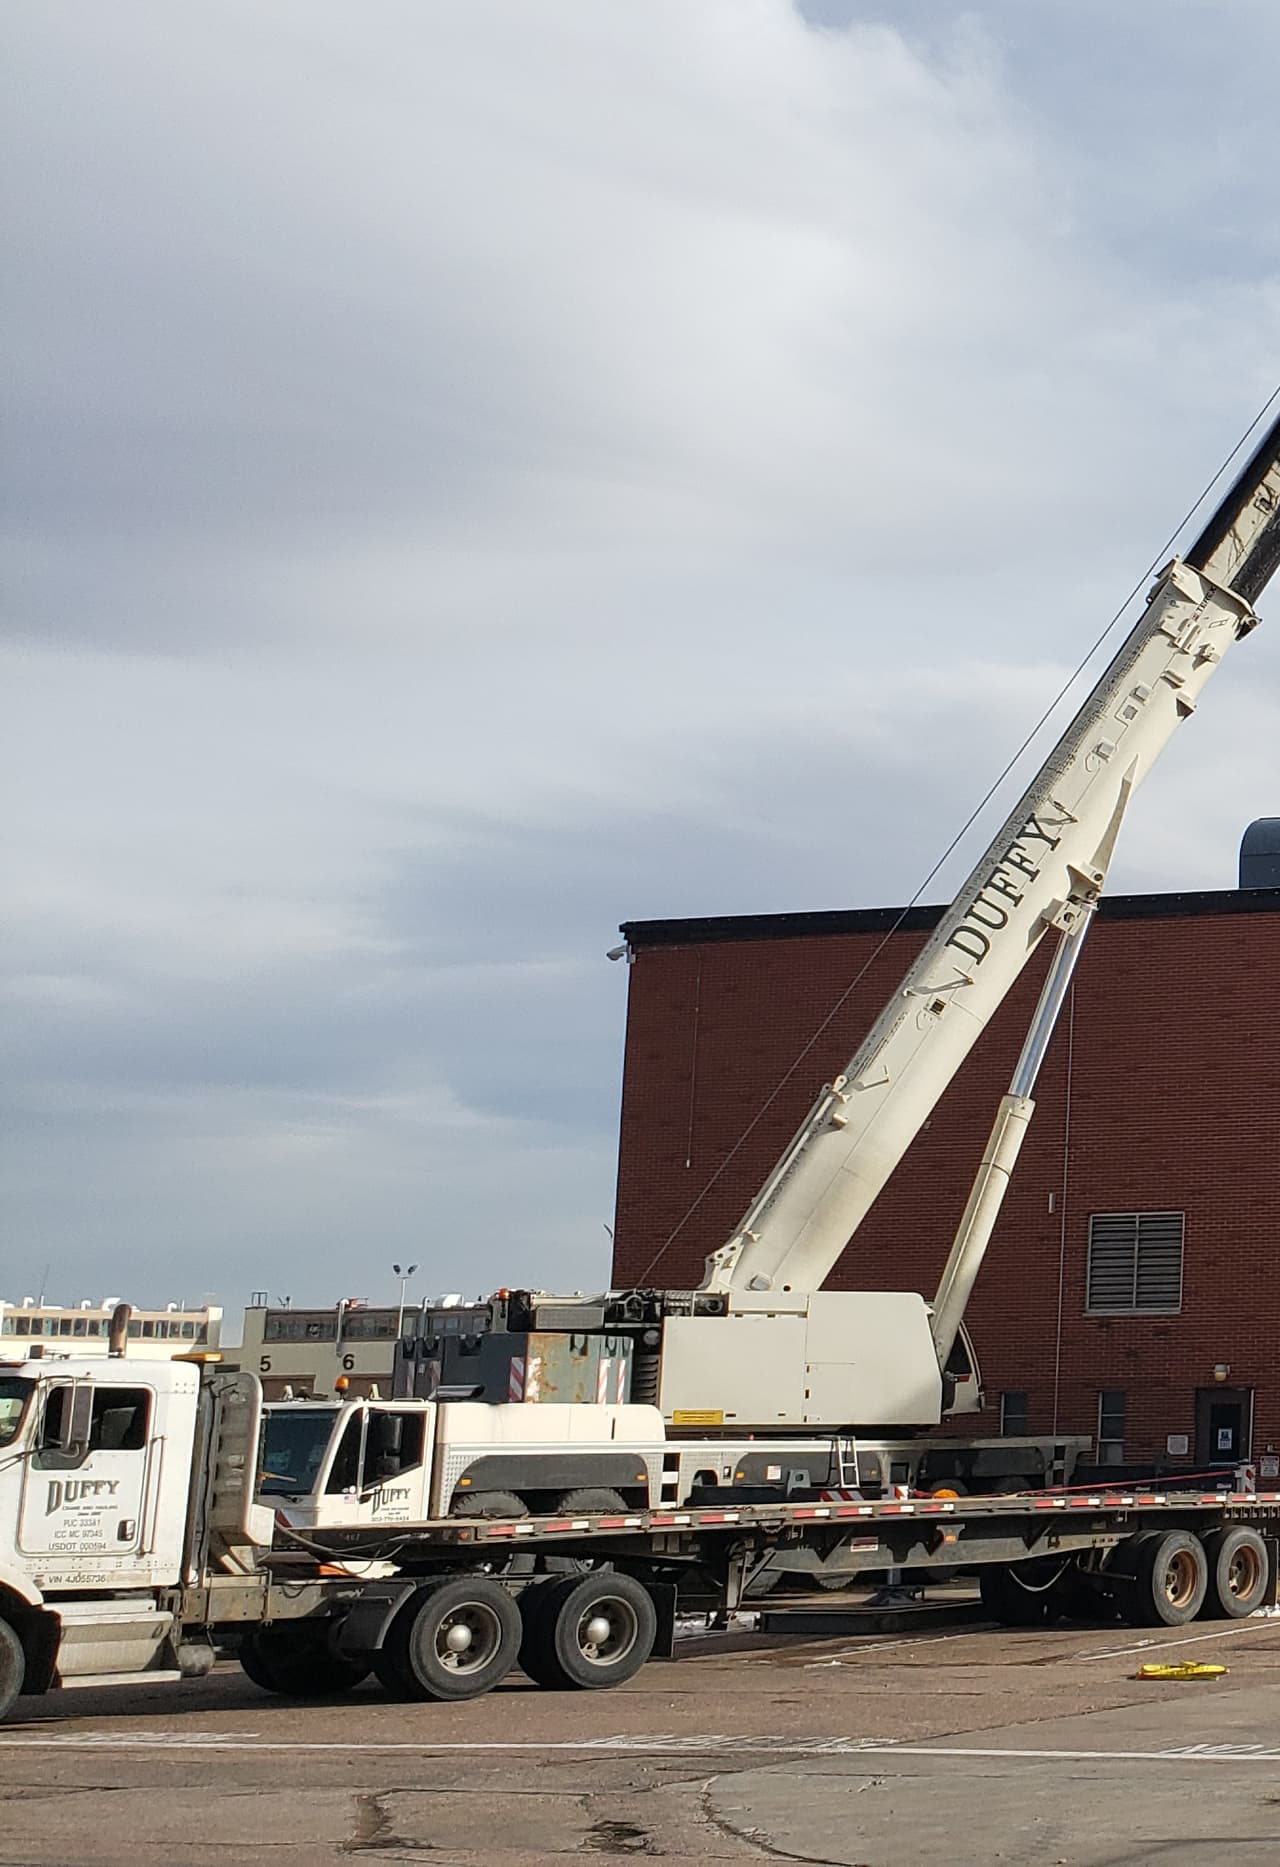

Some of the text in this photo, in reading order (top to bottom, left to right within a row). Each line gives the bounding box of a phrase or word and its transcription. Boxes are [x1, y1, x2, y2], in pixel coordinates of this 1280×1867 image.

[944, 813, 1062, 966] DUFFY
[260, 1355, 271, 1372] 5
[342, 1353, 355, 1370] 6
[45, 1480, 120, 1516] DUFFY
[372, 1488, 411, 1515] DUFFY
[69, 1530, 80, 1538] MC
[48, 1543, 77, 1551] USDOT
[49, 1576, 62, 1584] VIN
[1160, 1743, 1264, 1754] NO
